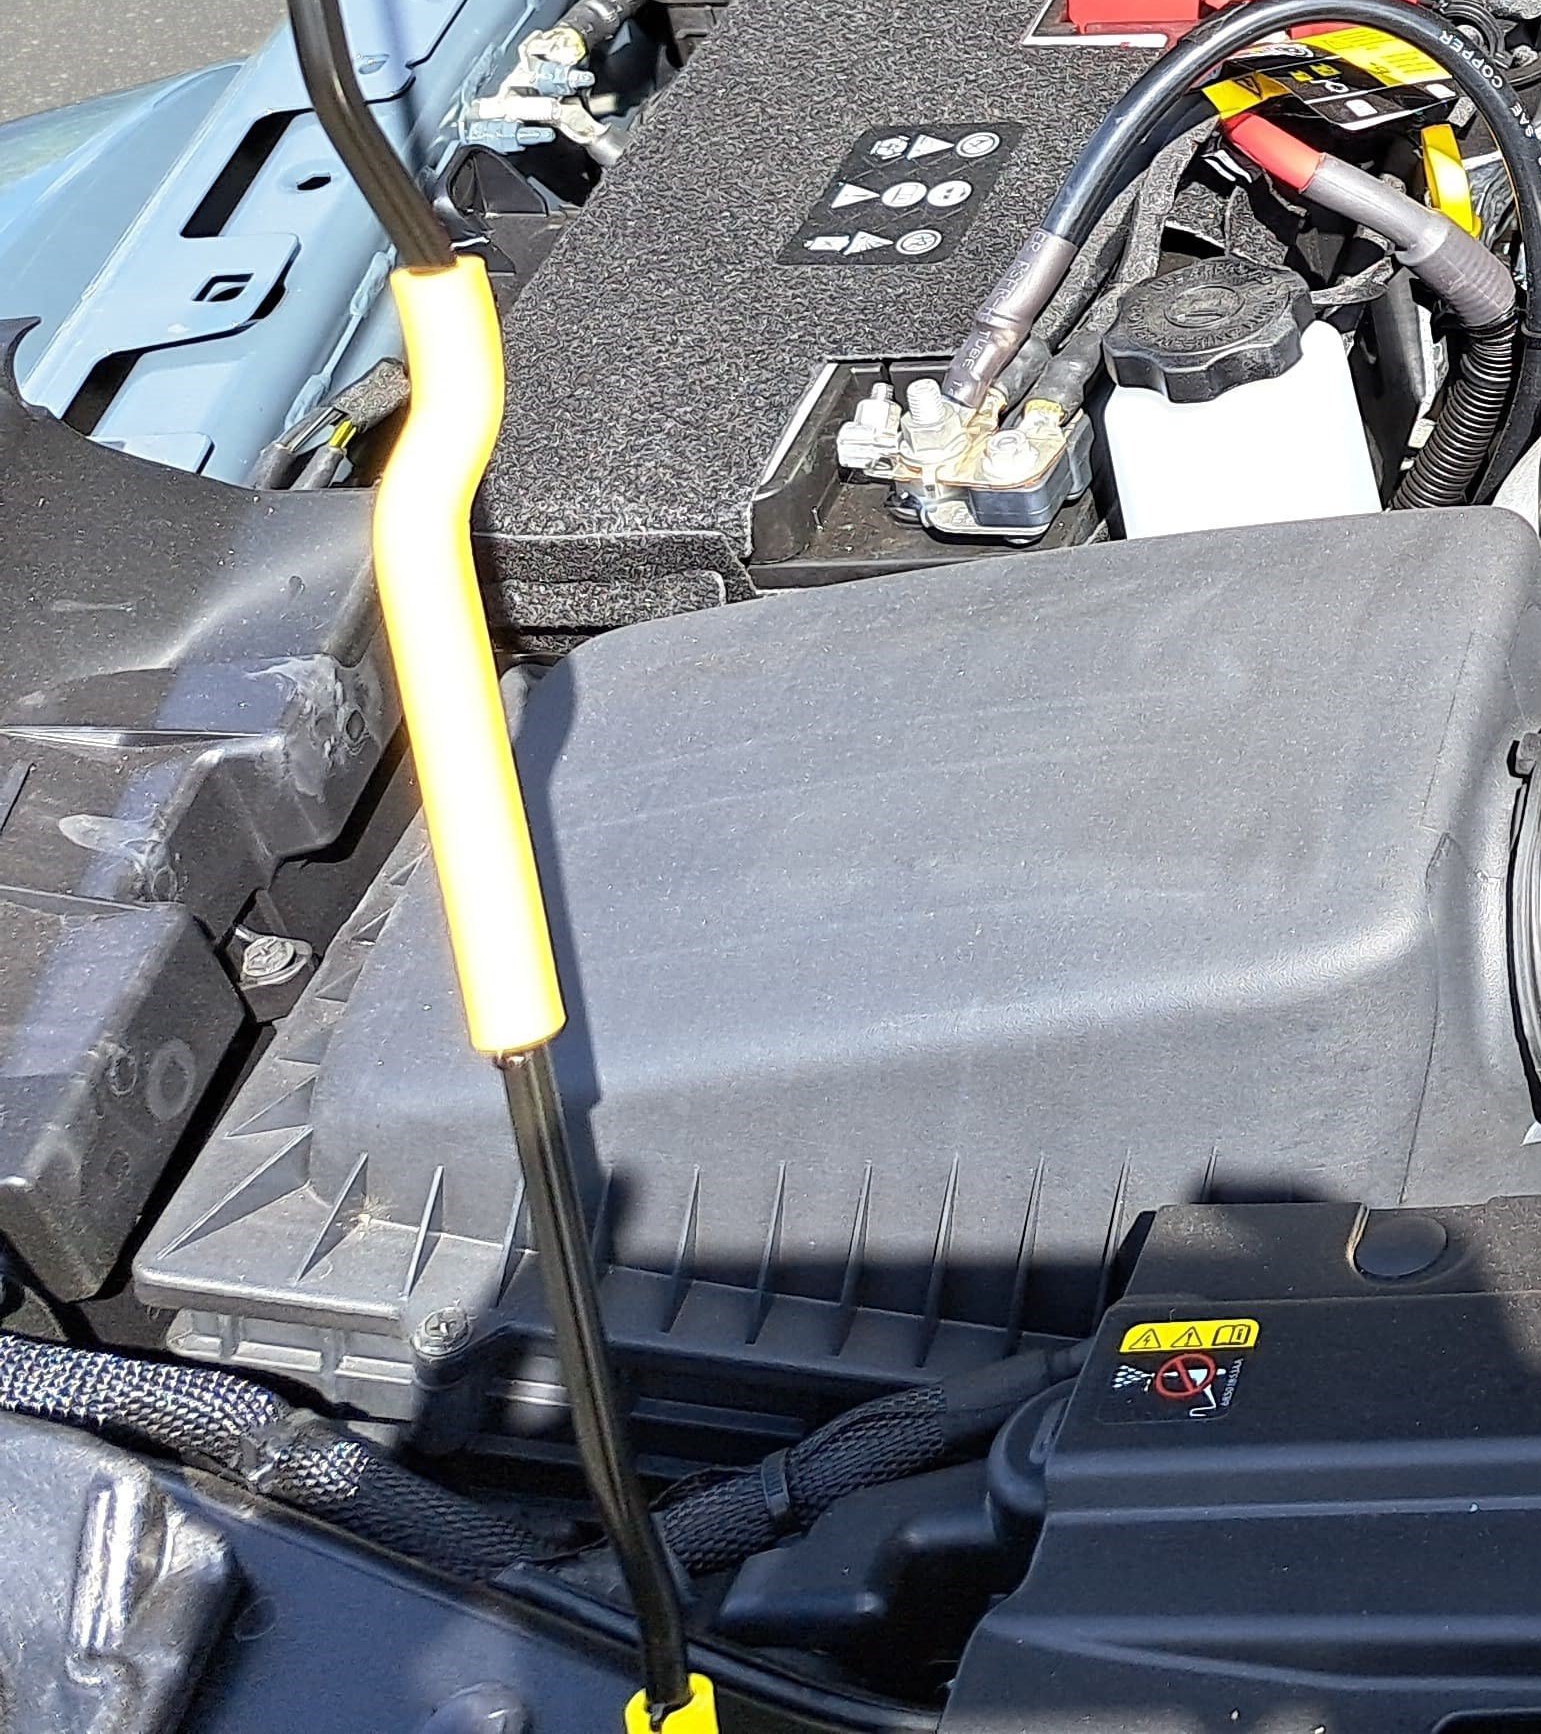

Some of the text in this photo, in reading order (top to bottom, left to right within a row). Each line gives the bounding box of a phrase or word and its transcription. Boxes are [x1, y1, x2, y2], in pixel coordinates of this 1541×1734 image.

[1439, 30, 1535, 138] SAE COPPER
[961, 330, 993, 368] TUBE
